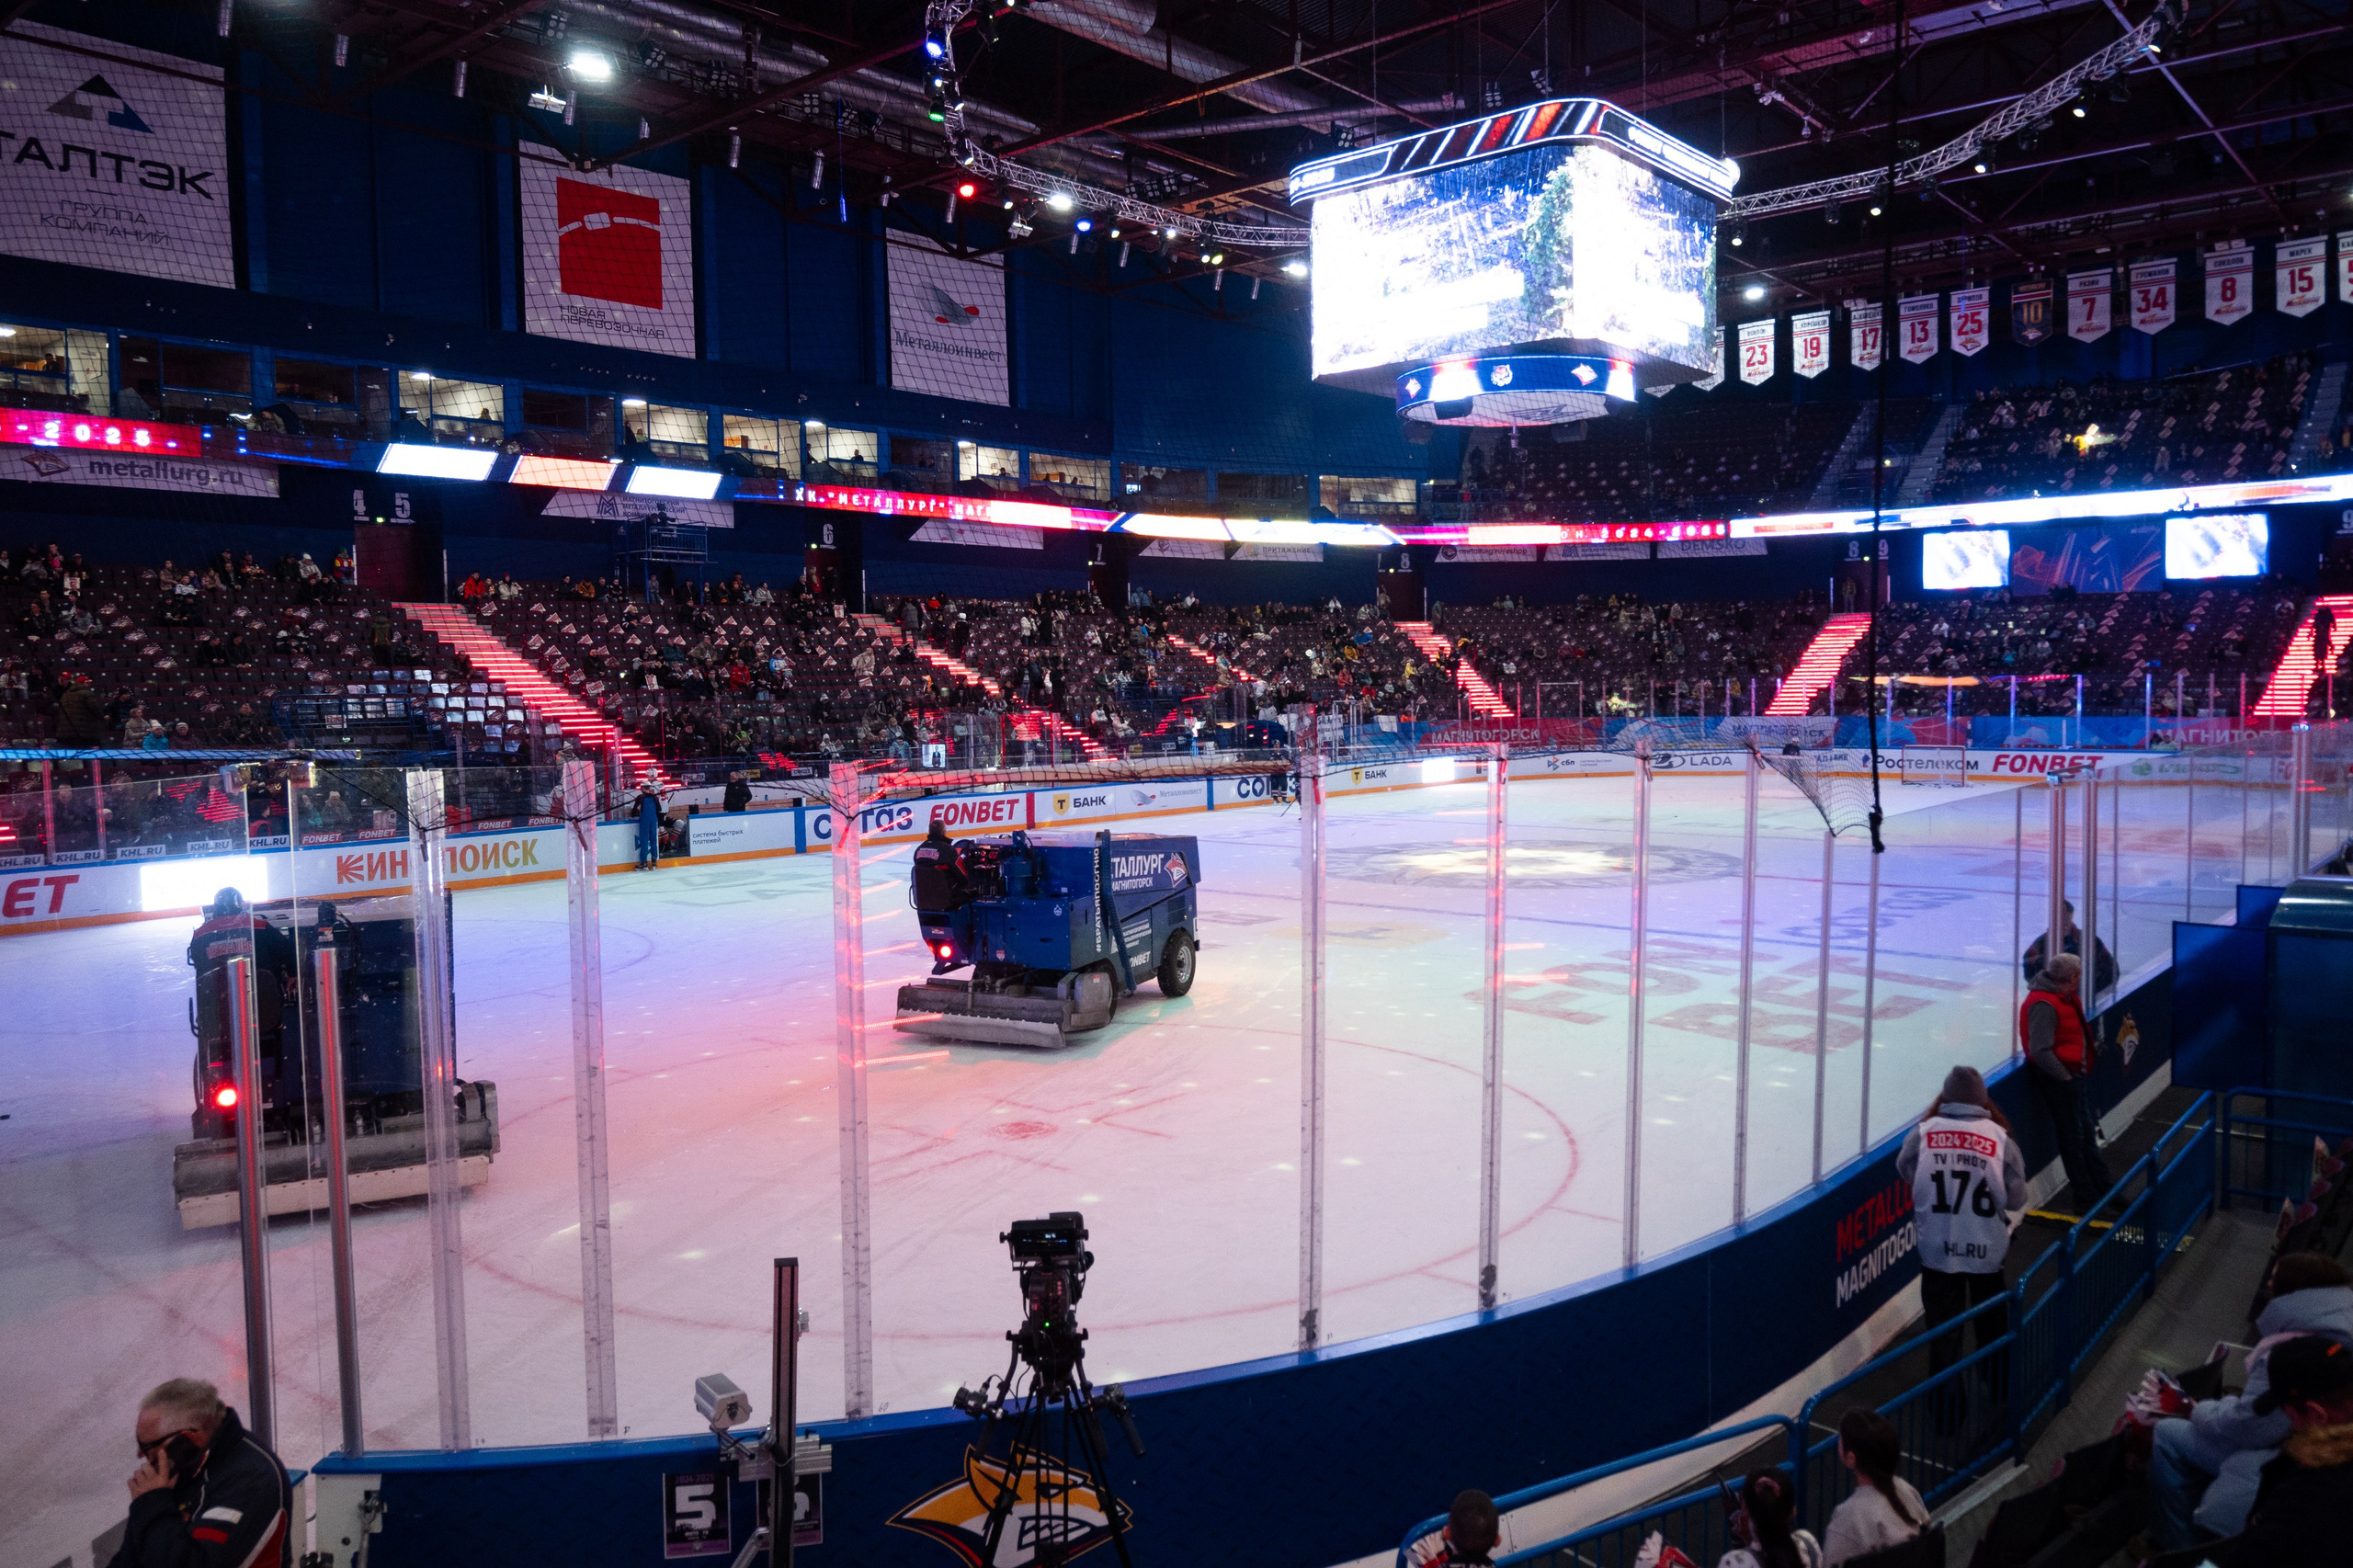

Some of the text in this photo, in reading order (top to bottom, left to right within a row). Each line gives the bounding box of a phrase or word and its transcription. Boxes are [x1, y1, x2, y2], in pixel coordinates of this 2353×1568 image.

[61, 199, 148, 226] ГРУППА
[40, 213, 170, 246] КОМПАНИЙ
[2221, 277, 2237, 302] 8
[2289, 267, 2313, 294] 15
[2083, 297, 2096, 321] 7
[2136, 287, 2168, 313] 34
[560, 304, 606, 320] НОВАЯ
[2023, 301, 2042, 325] 10
[560, 314, 665, 339] ПЕРЕВОЗОЧНАЯ
[1910, 320, 1929, 344] 13
[1958, 311, 1983, 336] 25
[895, 331, 1002, 363] Металлоинвест
[1802, 336, 1820, 358] 19
[1860, 327, 1880, 350] 17
[1746, 344, 1768, 367] 23
[89, 460, 244, 486] metallurg.ru
[353, 490, 411, 518] 4 5
[623, 496, 680, 508] МАГНИТОГОРСКИЙ
[623, 504, 686, 514] МЕТАЛЛУРГЕСКИЙ
[823, 523, 834, 545] 6
[1262, 546, 1312, 554] ПРИТЯЖЕНИЕ
[1848, 539, 1889, 558] 8 9
[1401, 552, 1411, 570] 8
[1432, 729, 1540, 744] МАГНИТОГОРСК
[1689, 756, 1733, 767] LADA
[1876, 755, 1980, 771] Ростелеком
[1365, 770, 1388, 779] БАНК
[1074, 796, 1107, 809] БАНК
[1160, 789, 1202, 797] Металлоинвест
[528, 815, 562, 826] FONBET
[930, 799, 1020, 826] FONBET
[358, 829, 396, 840] FONBET
[476, 820, 510, 831] FONBET
[718, 828, 745, 837] быстрых
[189, 841, 231, 853] KHL.RU
[250, 835, 288, 847] KHL.RU
[301, 832, 342, 845] FONBET
[692, 835, 722, 846] платежей
[56, 851, 101, 863] KHL.RU
[120, 846, 164, 858] KHL.RU
[336, 839, 539, 884] КИНПОИСК
[1111, 854, 1165, 880] ТАЛЛУРГ
[1093, 847, 1102, 953] #БРАТЬЯПООГНЮ
[1930, 1132, 1995, 1155] 2024 2025
[1933, 1153, 1987, 1171] TV PHOO
[1930, 1170, 1996, 1219] 176
[1836, 1179, 1915, 1264] METALLU
[1836, 1221, 1918, 1309] MAGNITOGO
[675, 1483, 717, 1530] 5
